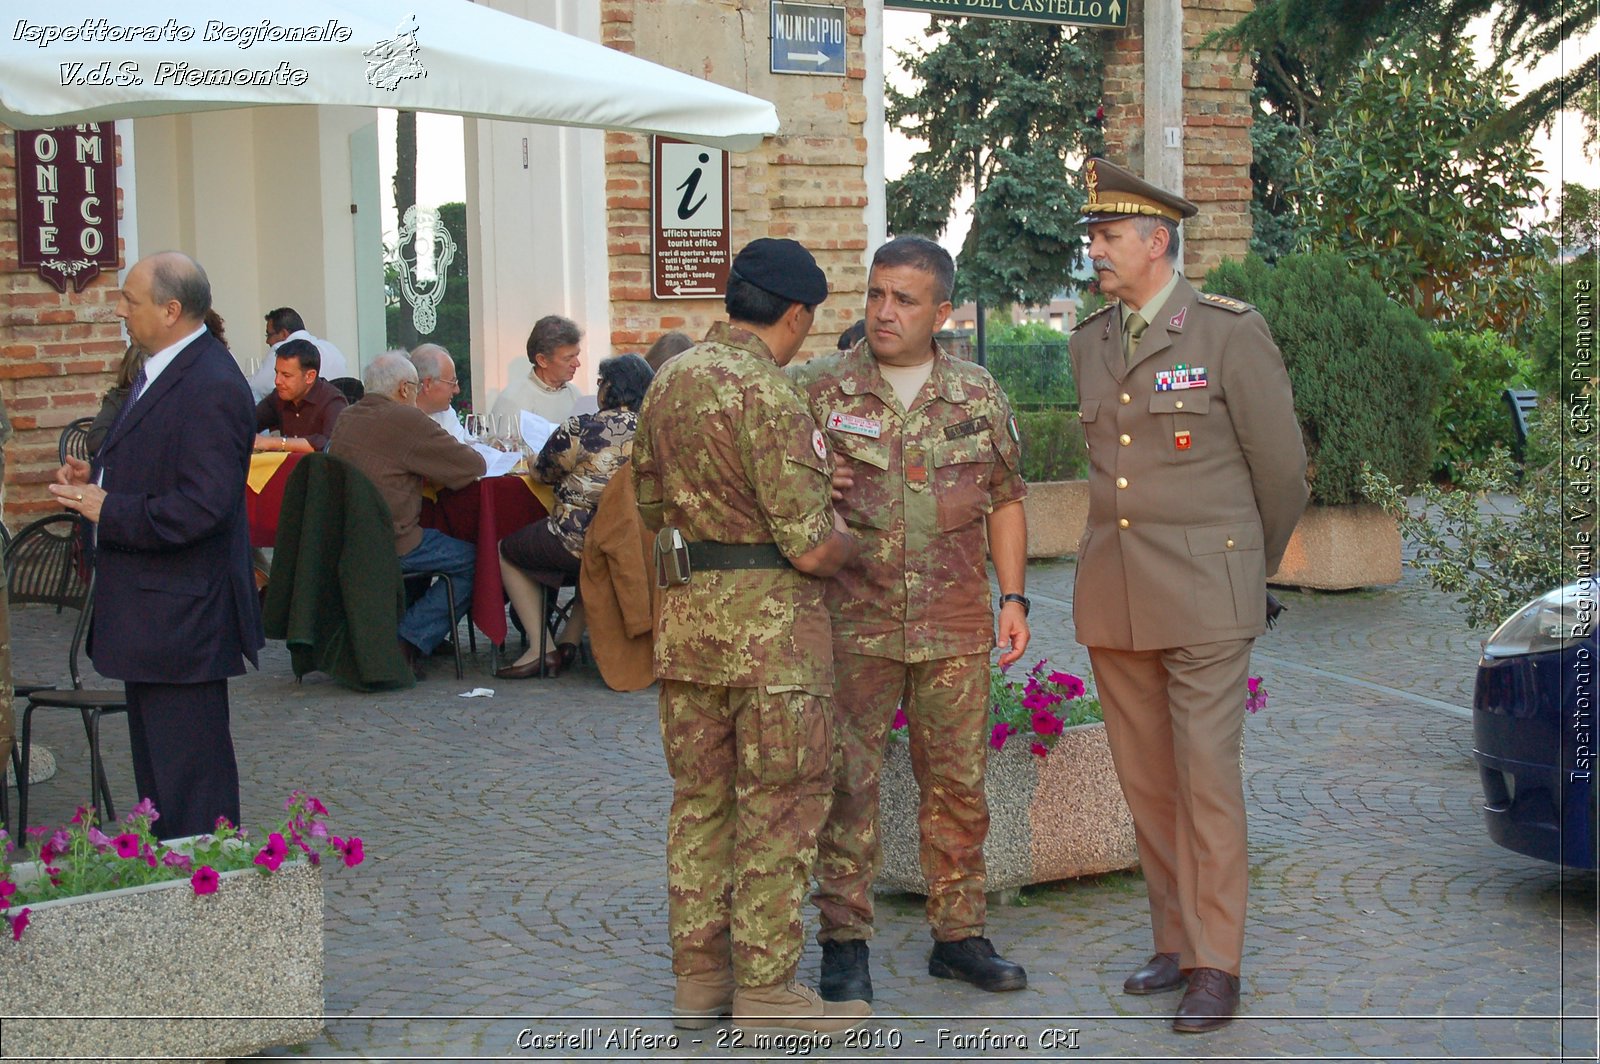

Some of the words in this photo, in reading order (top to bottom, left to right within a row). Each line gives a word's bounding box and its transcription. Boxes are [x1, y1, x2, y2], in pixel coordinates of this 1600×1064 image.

[1008, 0, 1102, 17] CASTELLO
[775, 13, 842, 45] MUNICIPIO
[34, 126, 60, 255] ONTE
[667, 239, 693, 247] tourist
[694, 238, 718, 247] office
[682, 256, 699, 265] giorni
